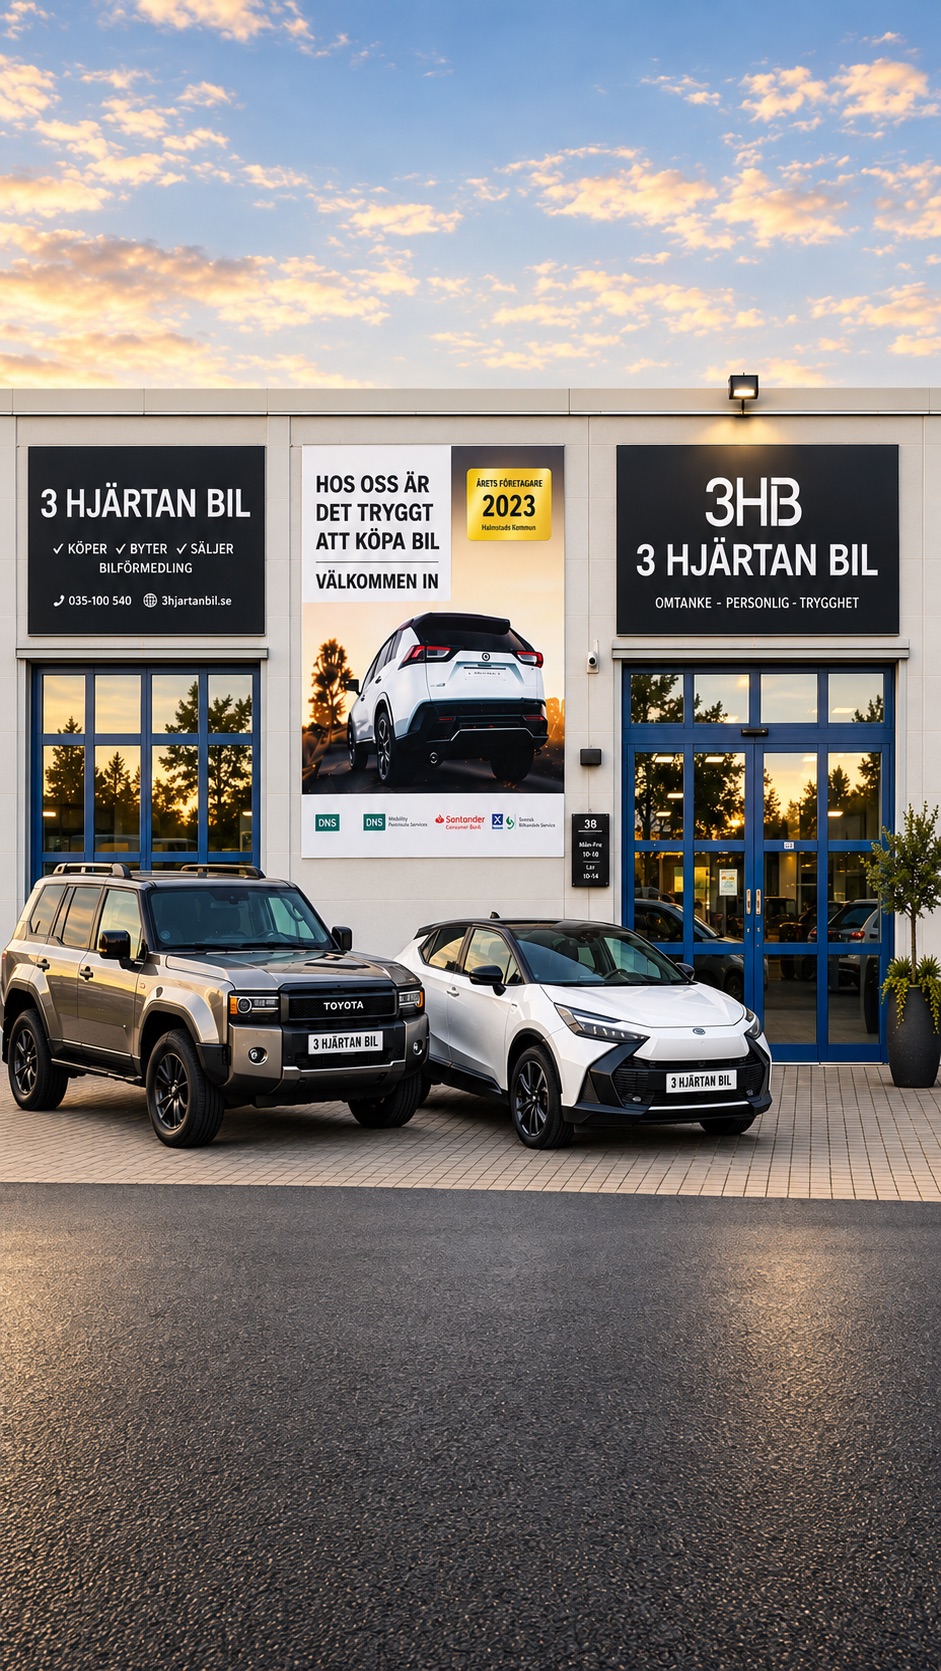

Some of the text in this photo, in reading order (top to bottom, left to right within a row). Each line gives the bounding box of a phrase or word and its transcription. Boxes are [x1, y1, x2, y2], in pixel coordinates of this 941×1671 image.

[316, 471, 430, 493] HOS OSS ÄR
[476, 478, 498, 488] ÅRETS
[40, 482, 251, 518] 3 HJÄRTAN BIL
[482, 494, 536, 517] 2023
[705, 476, 802, 527] 3HB
[316, 503, 434, 522] DET TRYGGT
[315, 528, 440, 550] ATT KÖPA BIL
[68, 540, 234, 555] KÖPER BYTER SÄLJER
[636, 537, 878, 577] 3 HJÄRTAN BIL
[99, 559, 193, 574] BILFÖRMEDLING
[316, 570, 439, 590] VÄLKOMMEN IN
[68, 595, 232, 608] 035-100 540 3hjartanbil.se
[655, 596, 712, 609] OMTANKE
[726, 596, 789, 609] PERSONLIG
[799, 596, 859, 609] TRYGGHET
[318, 818, 337, 828] DNS
[366, 818, 383, 827] DNS
[584, 819, 597, 829] 38
[323, 1000, 364, 1011] TOYOTA
[313, 1035, 379, 1050] 3 HJÄRTAN BIL
[670, 1074, 732, 1088] 3 HJÄRTAN BIL
